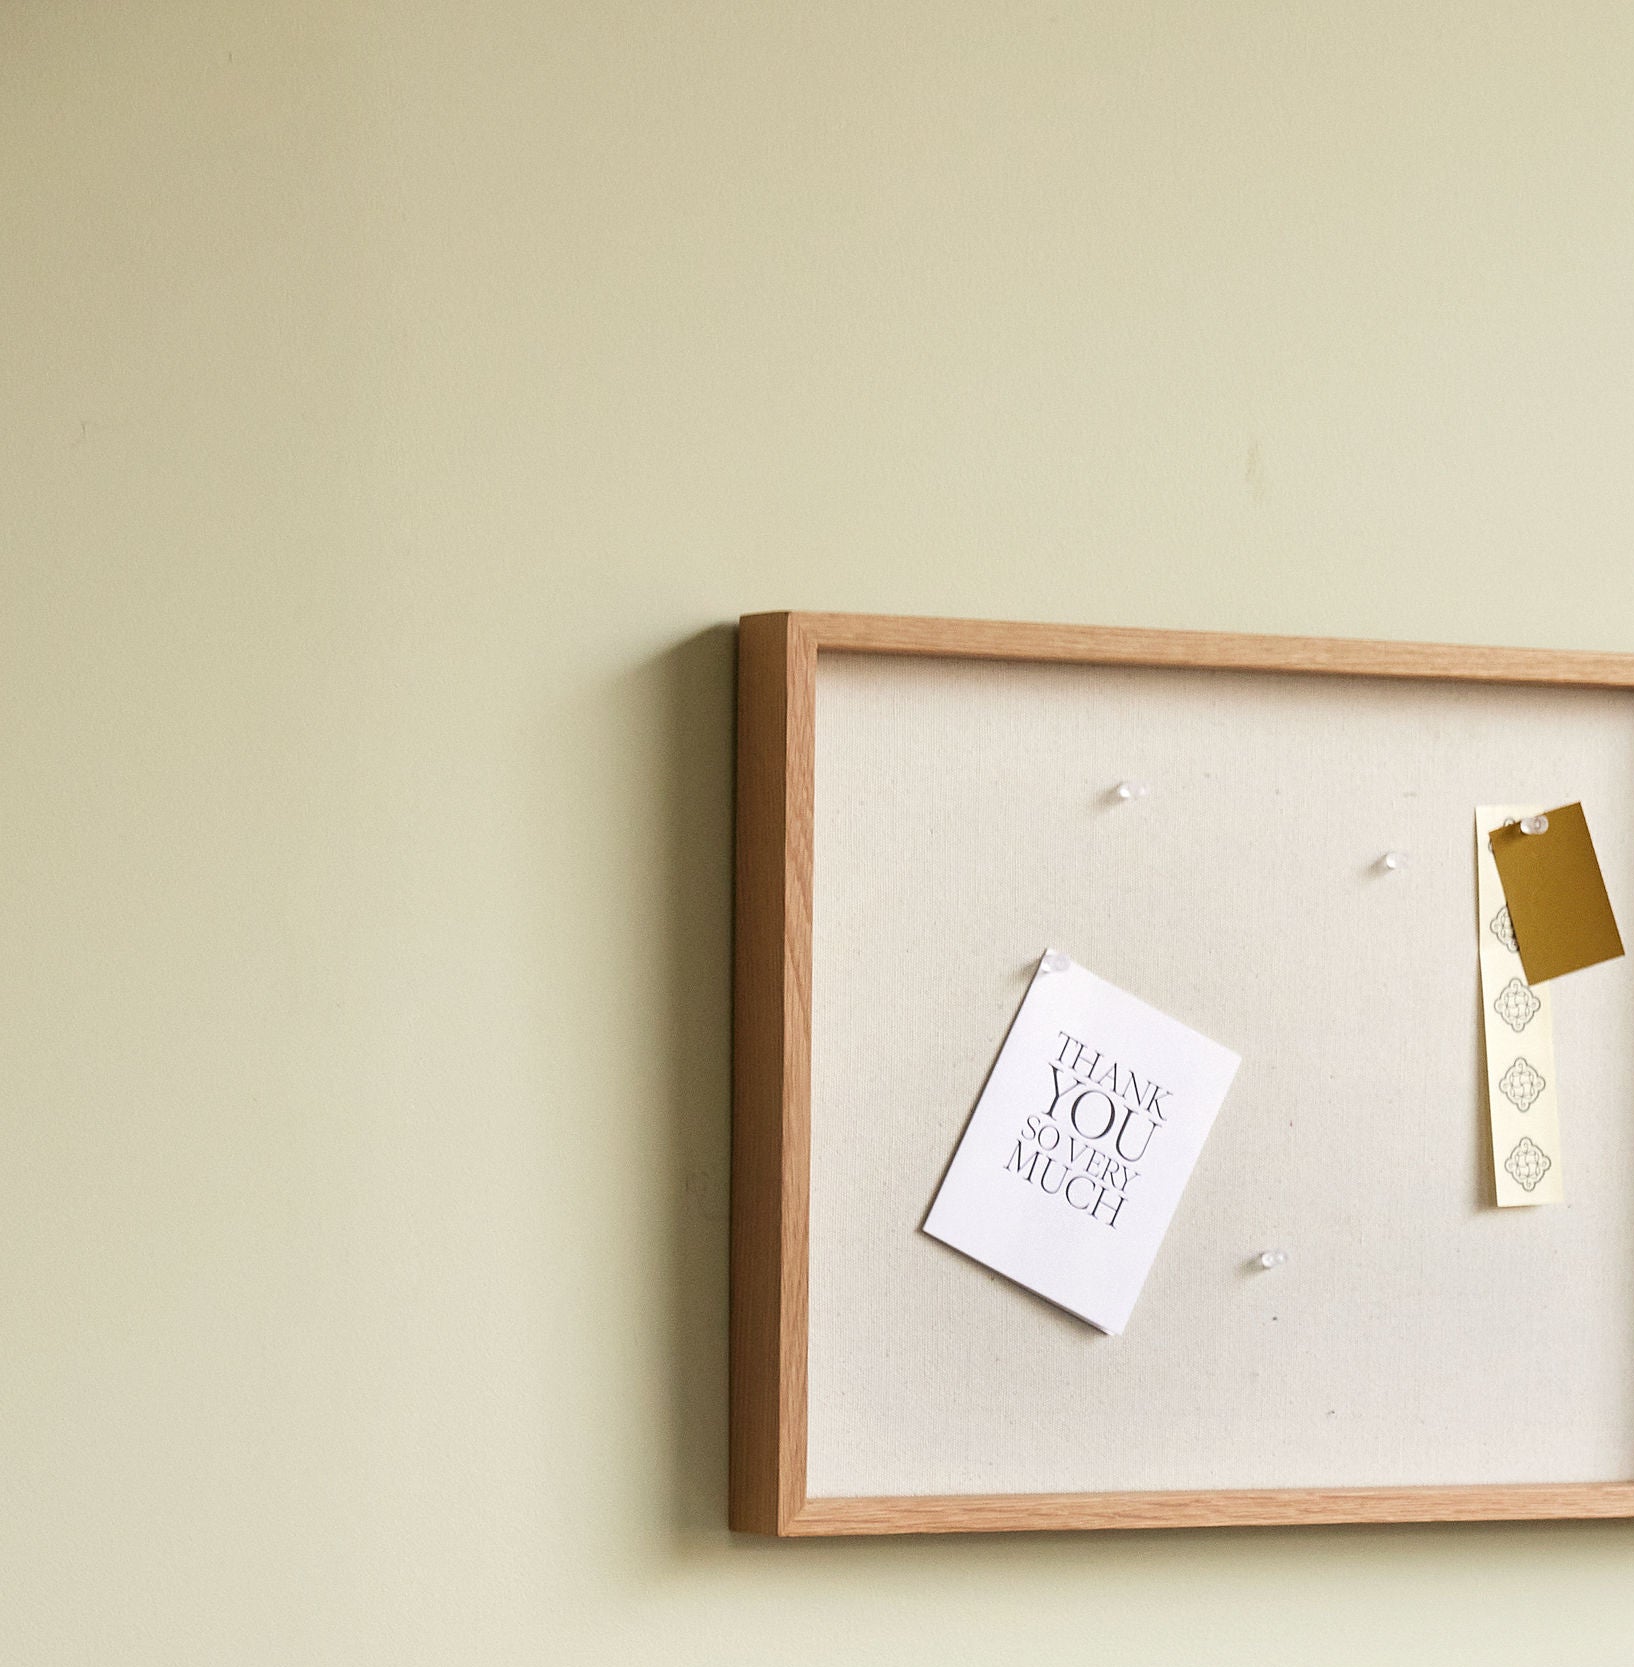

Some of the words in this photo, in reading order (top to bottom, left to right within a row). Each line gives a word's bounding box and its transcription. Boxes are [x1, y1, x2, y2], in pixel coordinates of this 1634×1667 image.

[1042, 1063, 1162, 1162] YOU
[1056, 1031, 1173, 1121] THANK
[1003, 1140, 1128, 1229] MUCH
[1021, 1115, 1061, 1151] SO
[1067, 1137, 1142, 1192] VERY
